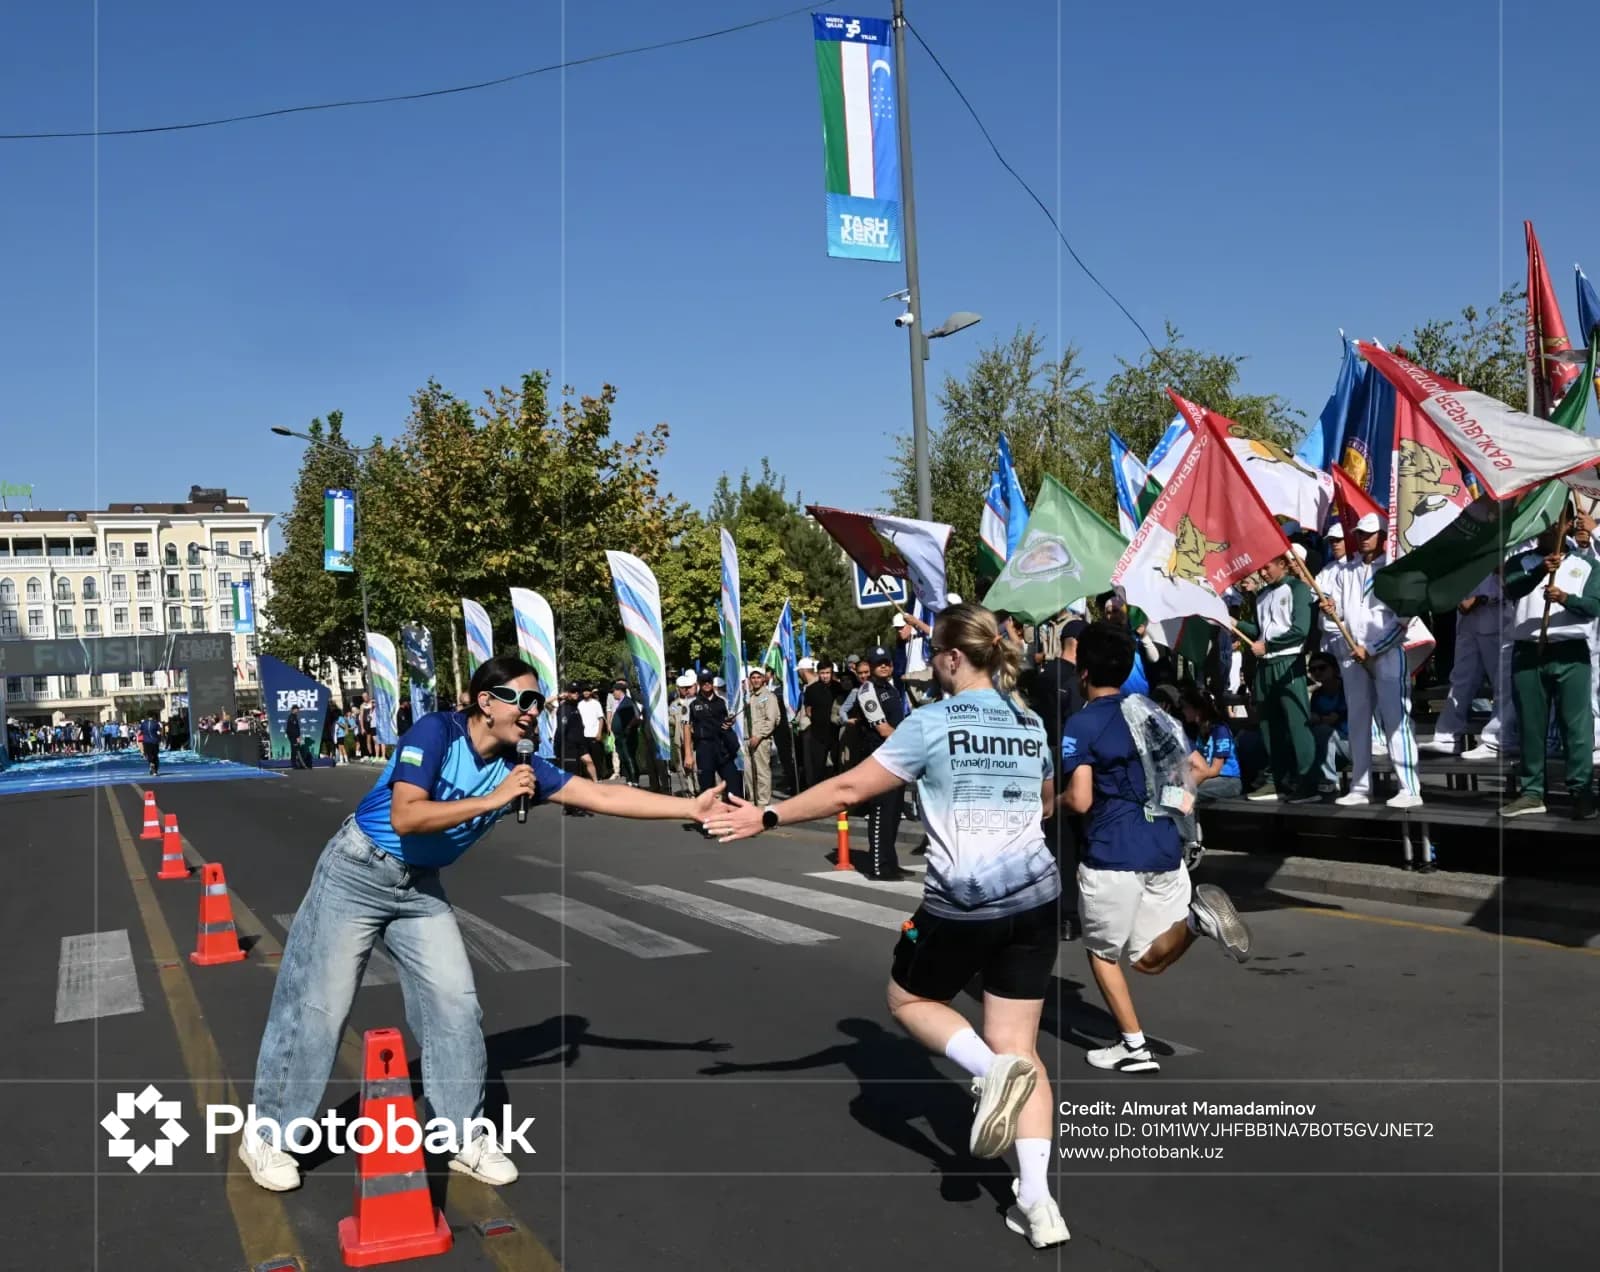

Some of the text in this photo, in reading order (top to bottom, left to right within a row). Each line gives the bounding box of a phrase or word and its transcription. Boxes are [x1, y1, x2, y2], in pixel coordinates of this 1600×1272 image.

[840, 214, 888, 235] TASH
[841, 226, 885, 245] KENT
[277, 689, 318, 701] TASH
[277, 699, 315, 709] KENT
[945, 703, 979, 713] 100%
[948, 729, 1043, 758] Runner
[992, 760, 1018, 769] noun
